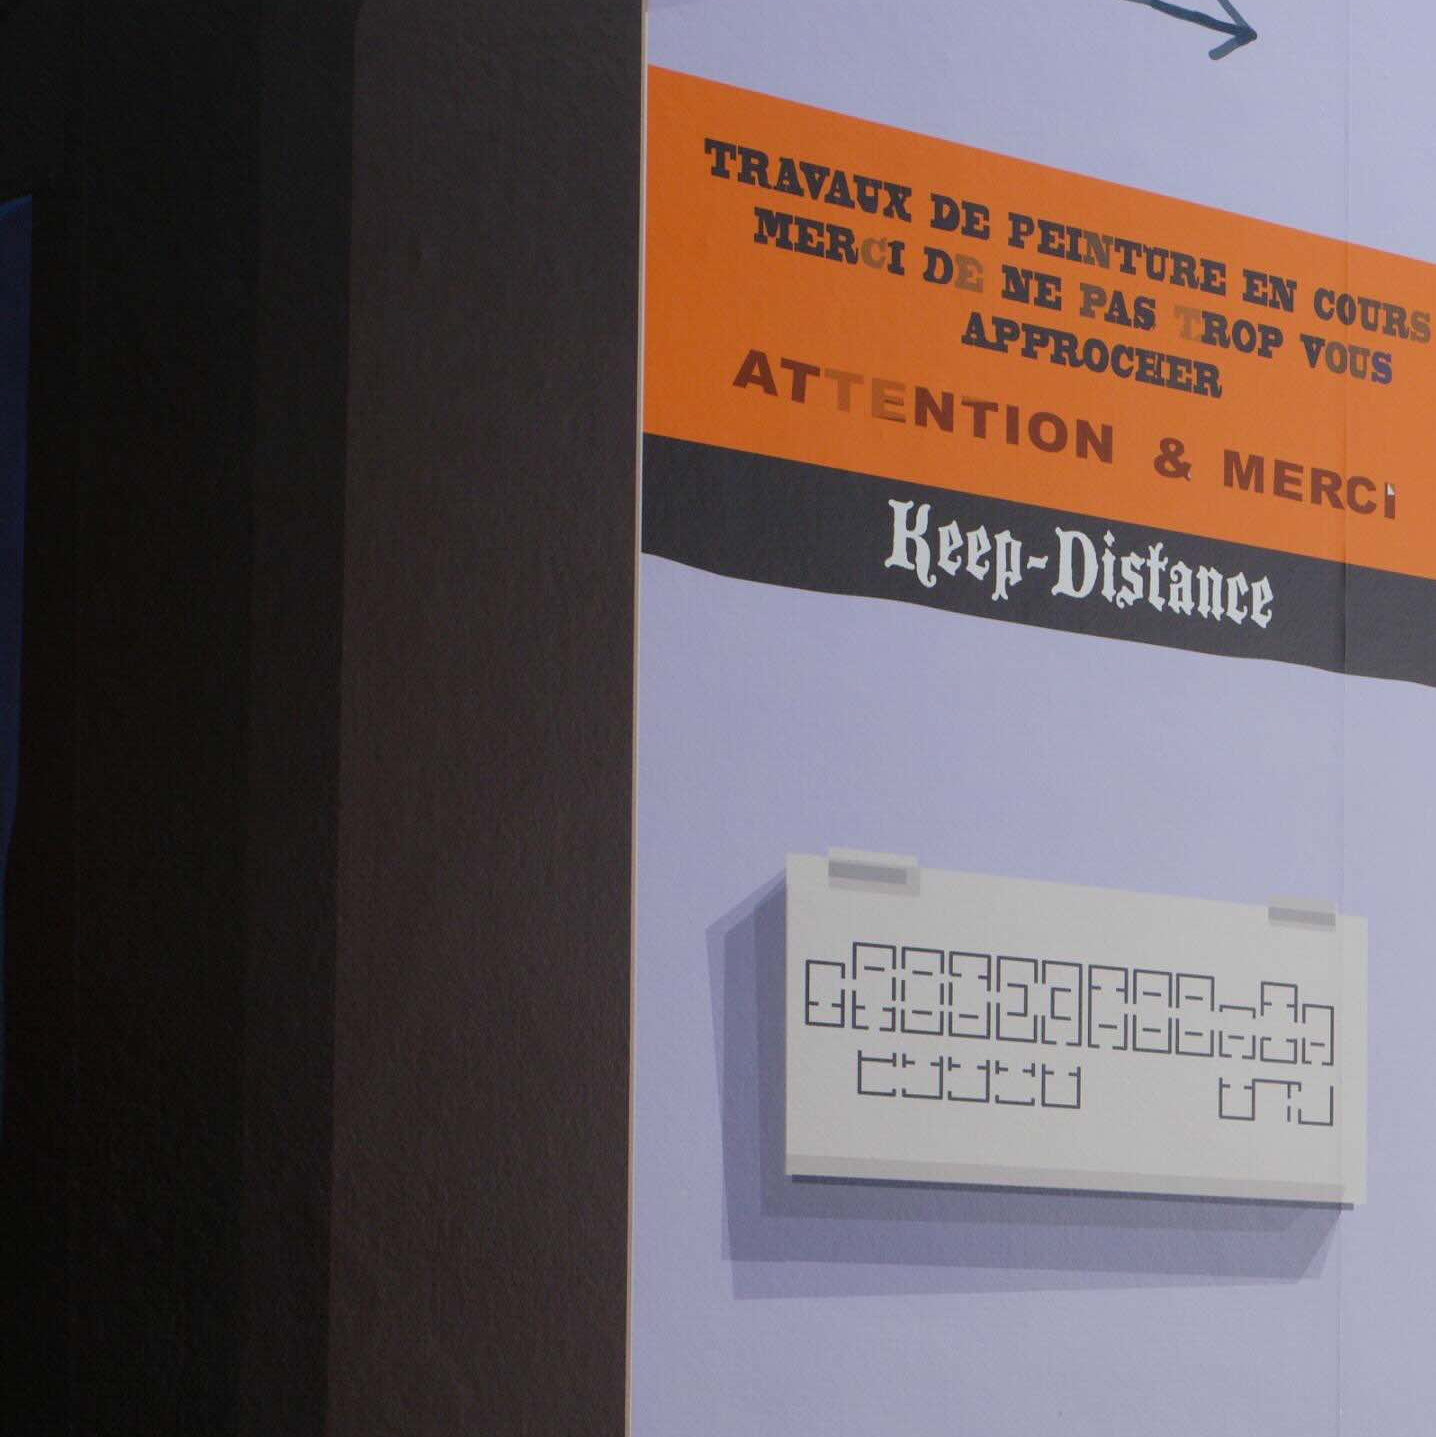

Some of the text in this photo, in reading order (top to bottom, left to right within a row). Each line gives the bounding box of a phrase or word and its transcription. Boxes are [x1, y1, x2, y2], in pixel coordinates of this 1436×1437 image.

[704, 137, 1432, 345] TRAVAUX DE PEINTURE EN COURS
[753, 205, 1393, 385] MERCI DE NE PAS TROP VOUS
[732, 348, 1396, 520] ATTENTION & MERCI
[961, 311, 1223, 399] APPROCHER
[884, 498, 1274, 629] Keep-Distance
